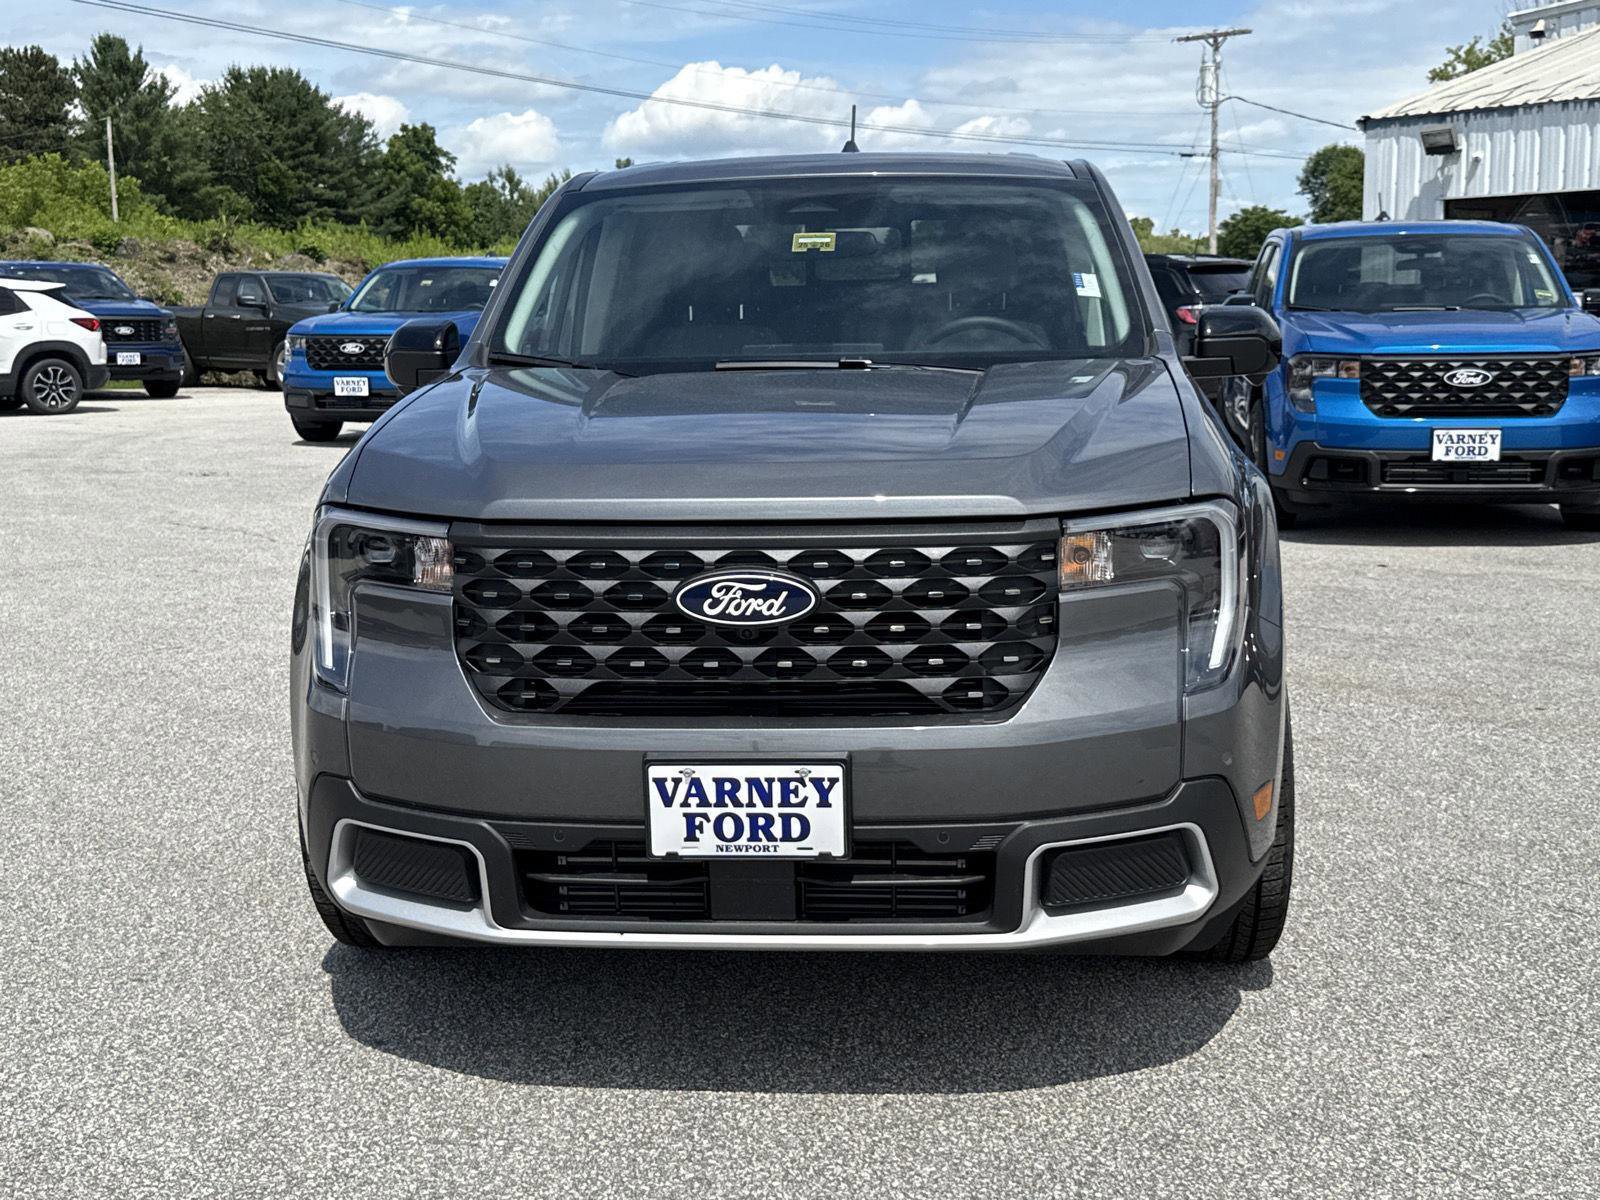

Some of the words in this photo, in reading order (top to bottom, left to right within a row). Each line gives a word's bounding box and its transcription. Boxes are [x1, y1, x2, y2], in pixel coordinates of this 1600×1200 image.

[1452, 370, 1483, 384] Ford
[1435, 433, 1499, 445] VARNEY
[1444, 445, 1488, 456] FORD
[702, 581, 789, 616] Ford
[652, 777, 840, 808] VARNEY
[682, 812, 811, 843] FORD
[715, 844, 780, 853] NEWPORT
